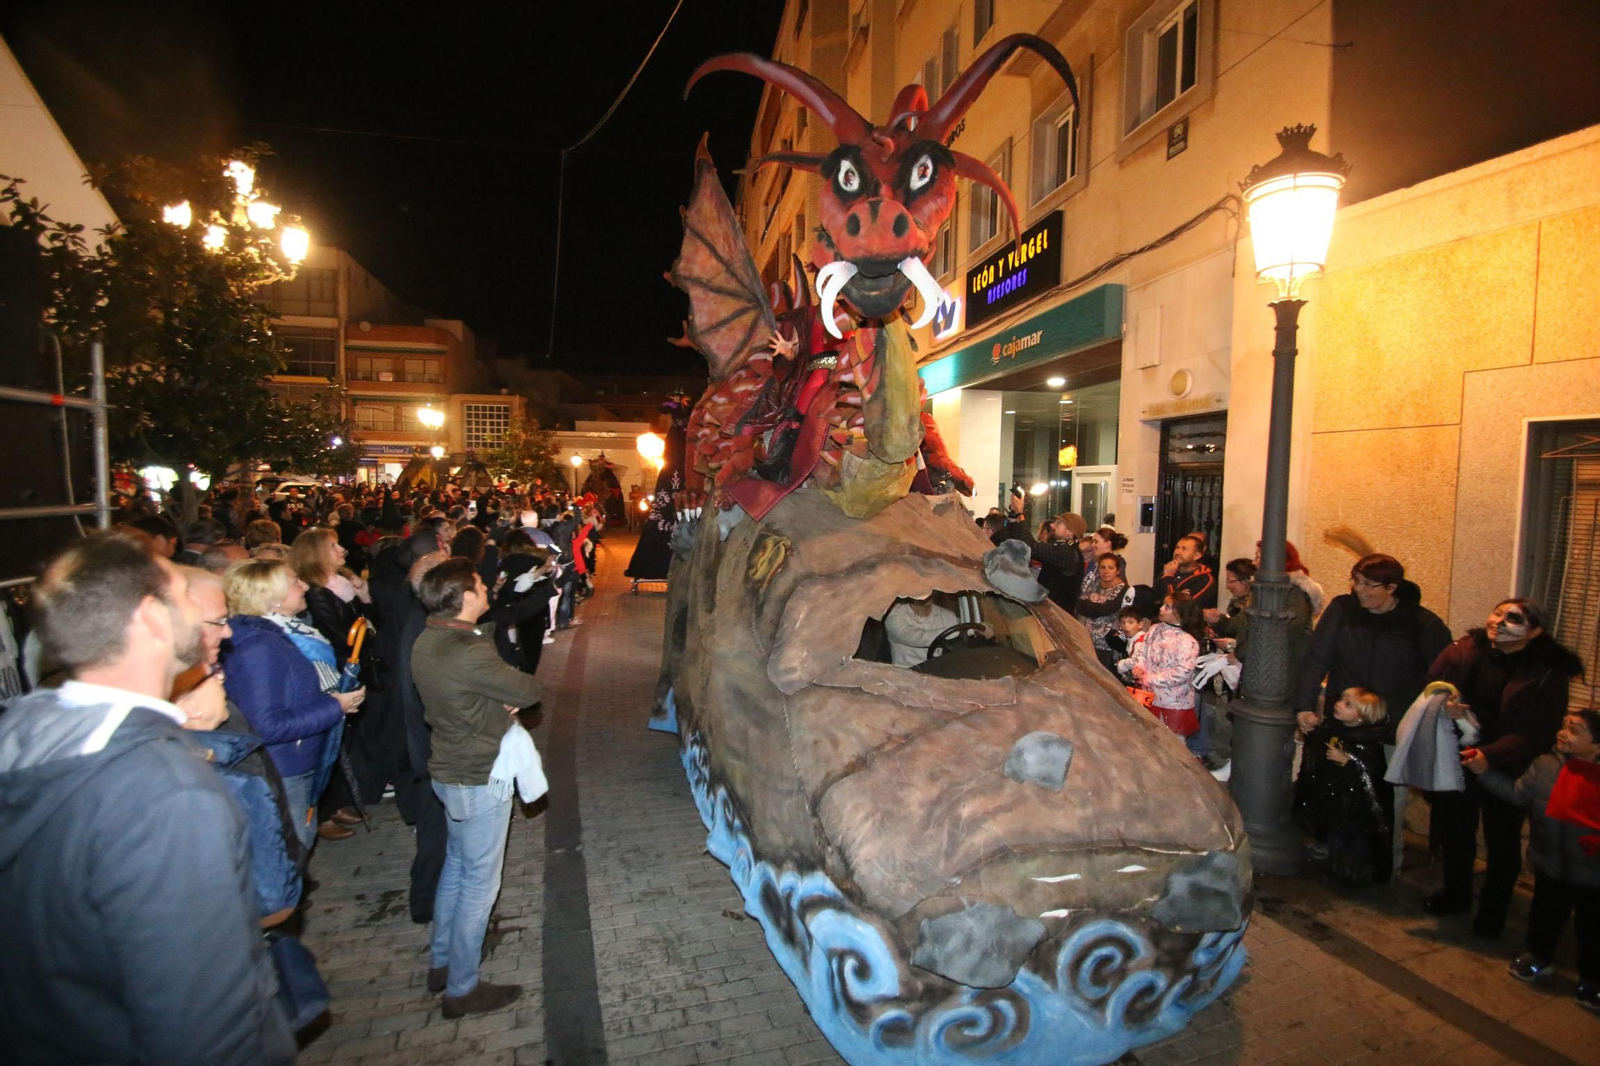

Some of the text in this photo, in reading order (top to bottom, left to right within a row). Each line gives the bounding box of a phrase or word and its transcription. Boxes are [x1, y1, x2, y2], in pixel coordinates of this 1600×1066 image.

[972, 228, 1049, 294] LEÓN Y VERGEL
[987, 267, 1028, 305] ASESORES
[1002, 330, 1043, 359] cajamar
